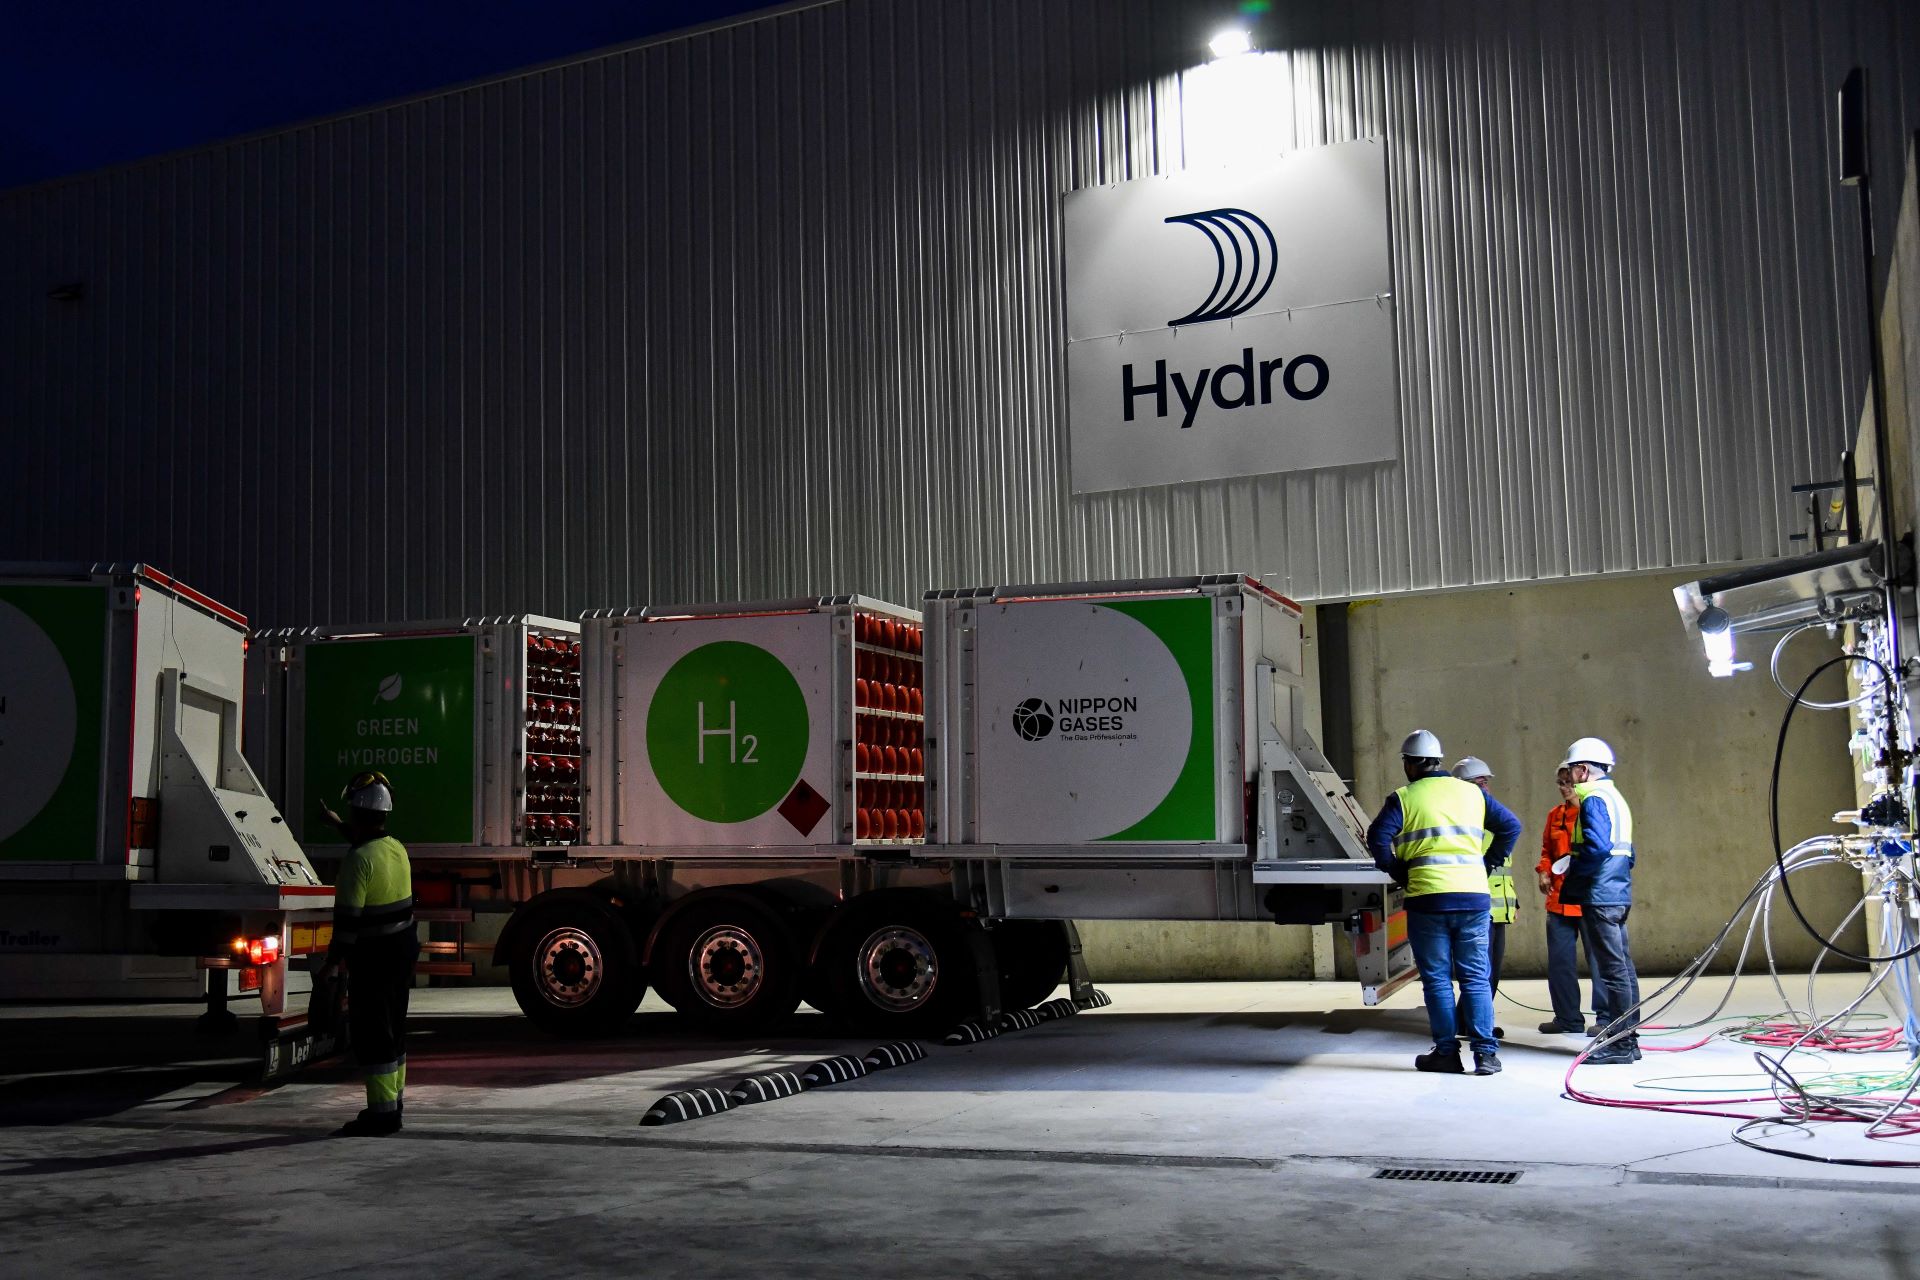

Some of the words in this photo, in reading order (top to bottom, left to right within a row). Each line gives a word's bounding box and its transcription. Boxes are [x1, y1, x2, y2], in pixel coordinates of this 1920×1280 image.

[1122, 347, 1330, 429] Hydro
[1059, 697, 1137, 714] NIPPON
[356, 718, 419, 736] GREEN
[698, 700, 759, 764] H2
[1059, 716, 1123, 732] GASES
[337, 747, 439, 767] HYDROGEN
